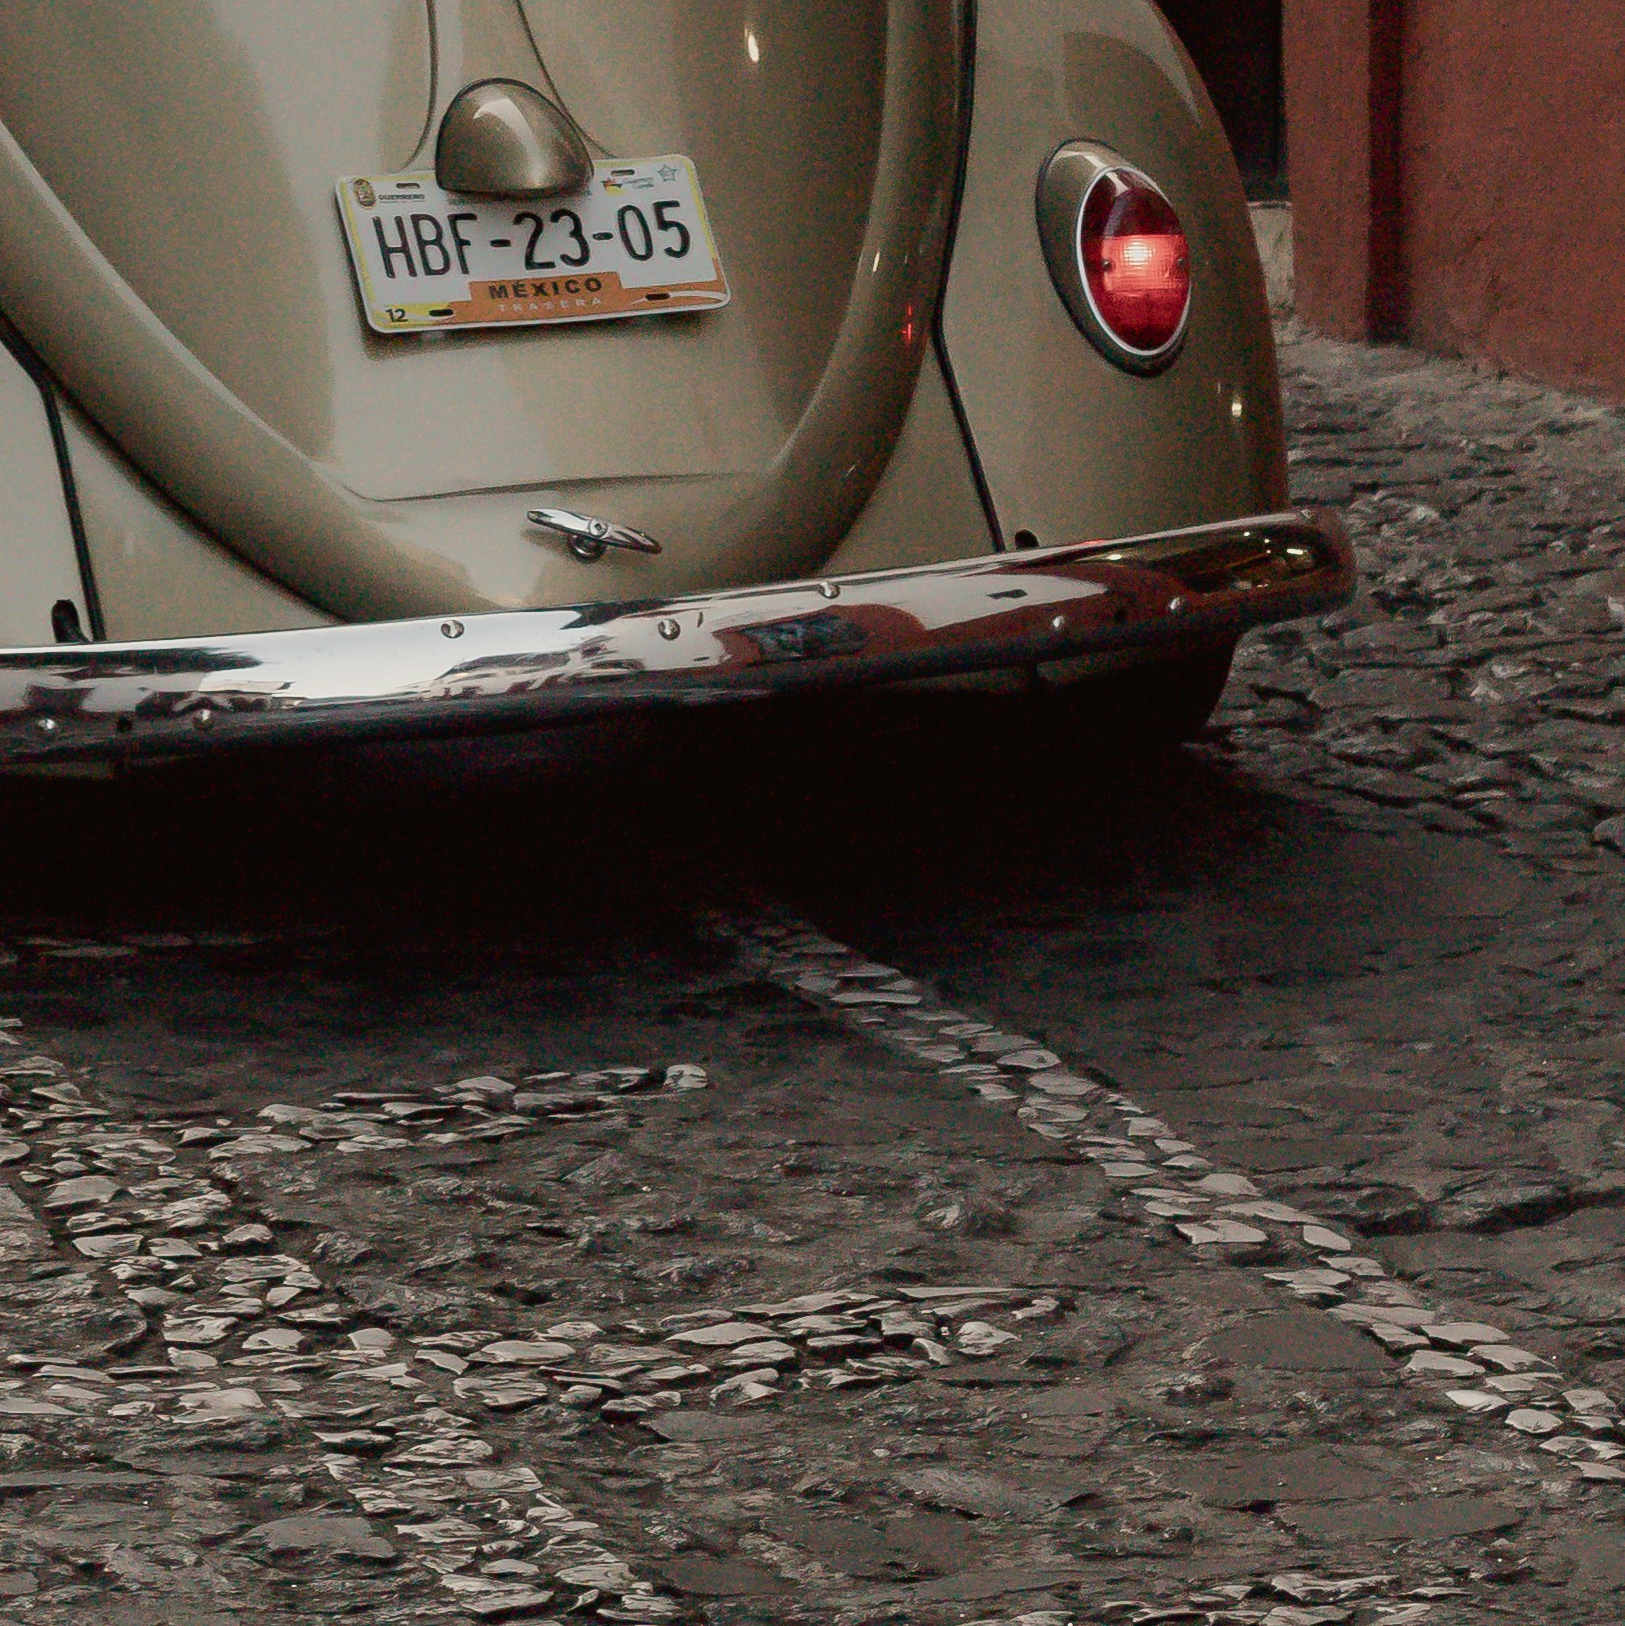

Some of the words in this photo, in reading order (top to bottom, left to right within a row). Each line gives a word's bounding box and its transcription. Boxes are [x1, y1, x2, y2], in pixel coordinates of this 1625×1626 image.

[373, 199, 692, 279] HBF-23-05
[497, 298, 603, 313] TRASERA
[385, 307, 409, 324] 12
